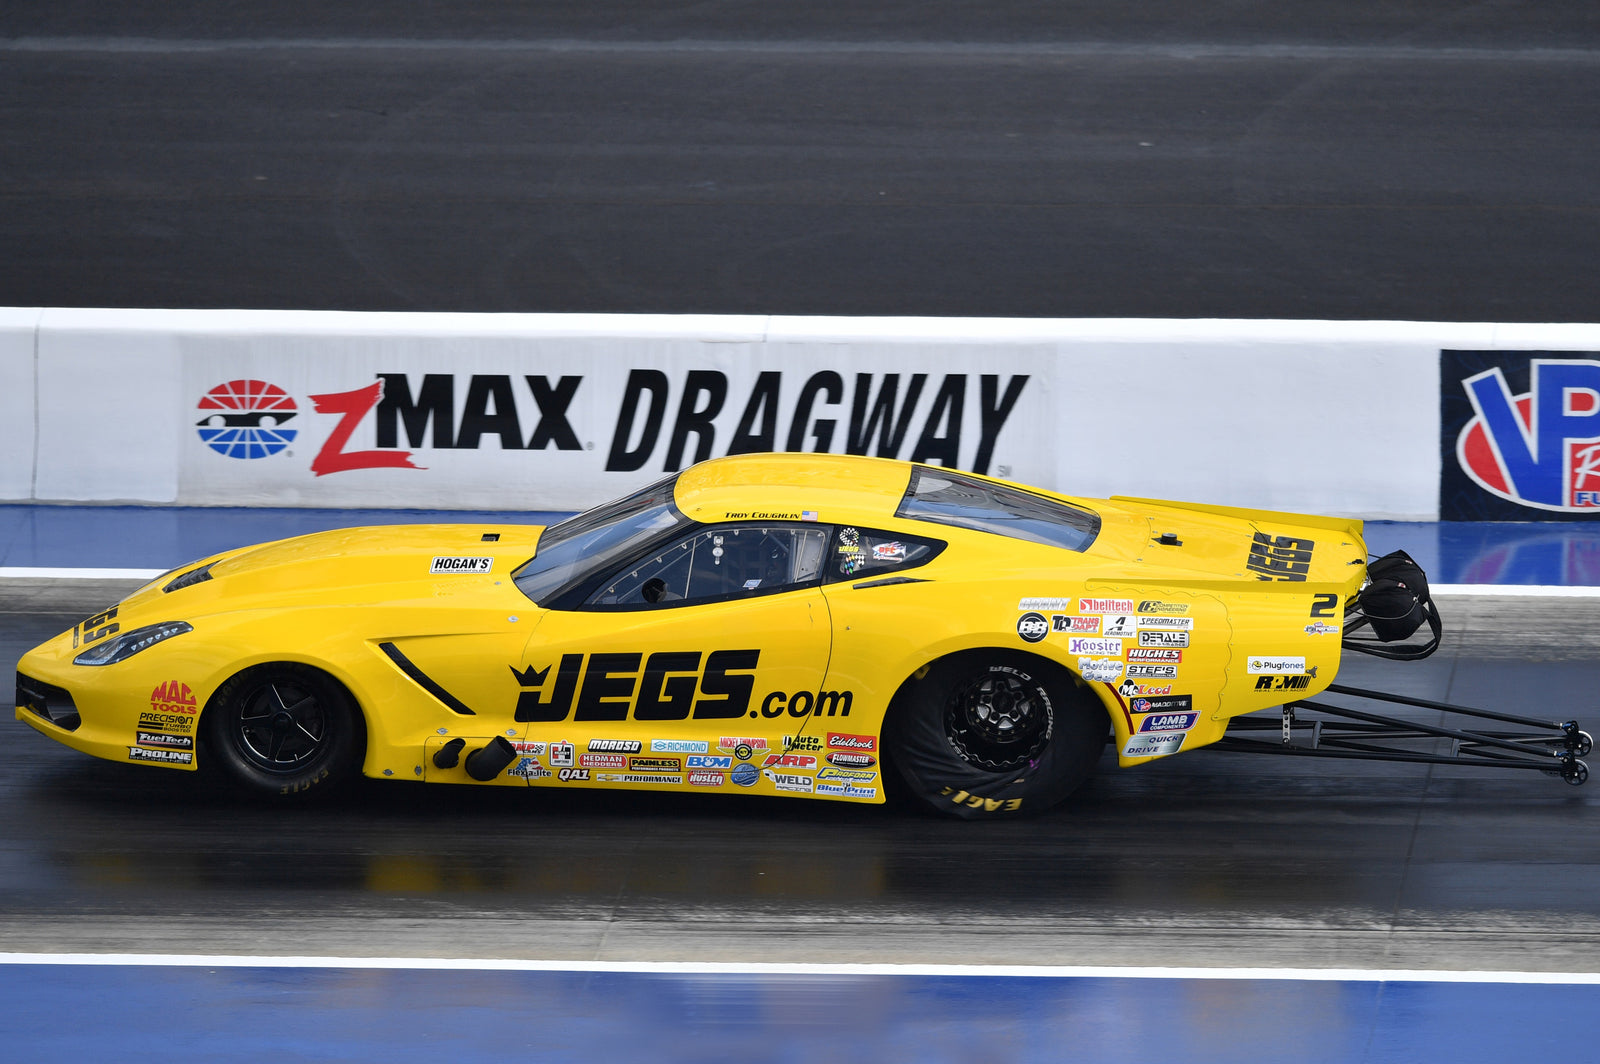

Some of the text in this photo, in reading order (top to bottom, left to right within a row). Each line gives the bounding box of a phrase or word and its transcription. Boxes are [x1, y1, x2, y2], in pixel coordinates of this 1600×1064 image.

[605, 370, 1029, 476] DRAGWAY
[725, 511, 800, 519] TROY COUGHLIN
[1246, 532, 1314, 582] JEGS
[434, 558, 490, 569] HOGAN'S
[1310, 593, 1338, 617] 2
[1071, 617, 1100, 625] TRANS
[1139, 618, 1190, 626] SPEEDMASTER
[1142, 632, 1185, 643] DERALE
[1070, 639, 1120, 652] Hoosier
[1128, 649, 1180, 658] HUGHES
[1128, 665, 1175, 674] STEF'S
[1264, 661, 1304, 670] Plugfones
[514, 648, 854, 723] JEGS.com
[150, 680, 197, 705] MAC
[150, 703, 197, 715] TOOLS
[140, 712, 194, 724] PRECISION
[1150, 714, 1188, 725] LAMB
[139, 733, 191, 745] FuelTech
[794, 735, 819, 744] Auto
[830, 735, 873, 749] Edelbrock
[1148, 735, 1179, 744] QUICK
[589, 740, 641, 751] MOROSO
[668, 742, 707, 752] RICHMOND
[792, 743, 823, 752] Meter
[1127, 746, 1159, 754] DRIVE
[130, 747, 192, 761] PROLINE
[583, 755, 623, 763] HEDMAN
[832, 754, 869, 763] FLOWMASTER
[632, 759, 679, 767] PAINLESS
[687, 756, 731, 768] B&M
[764, 755, 816, 767] ARP
[558, 769, 590, 781] QA1
[624, 775, 682, 783] PERFORMANCE
[820, 769, 874, 779] PROFORM
[774, 775, 812, 786] WELD
